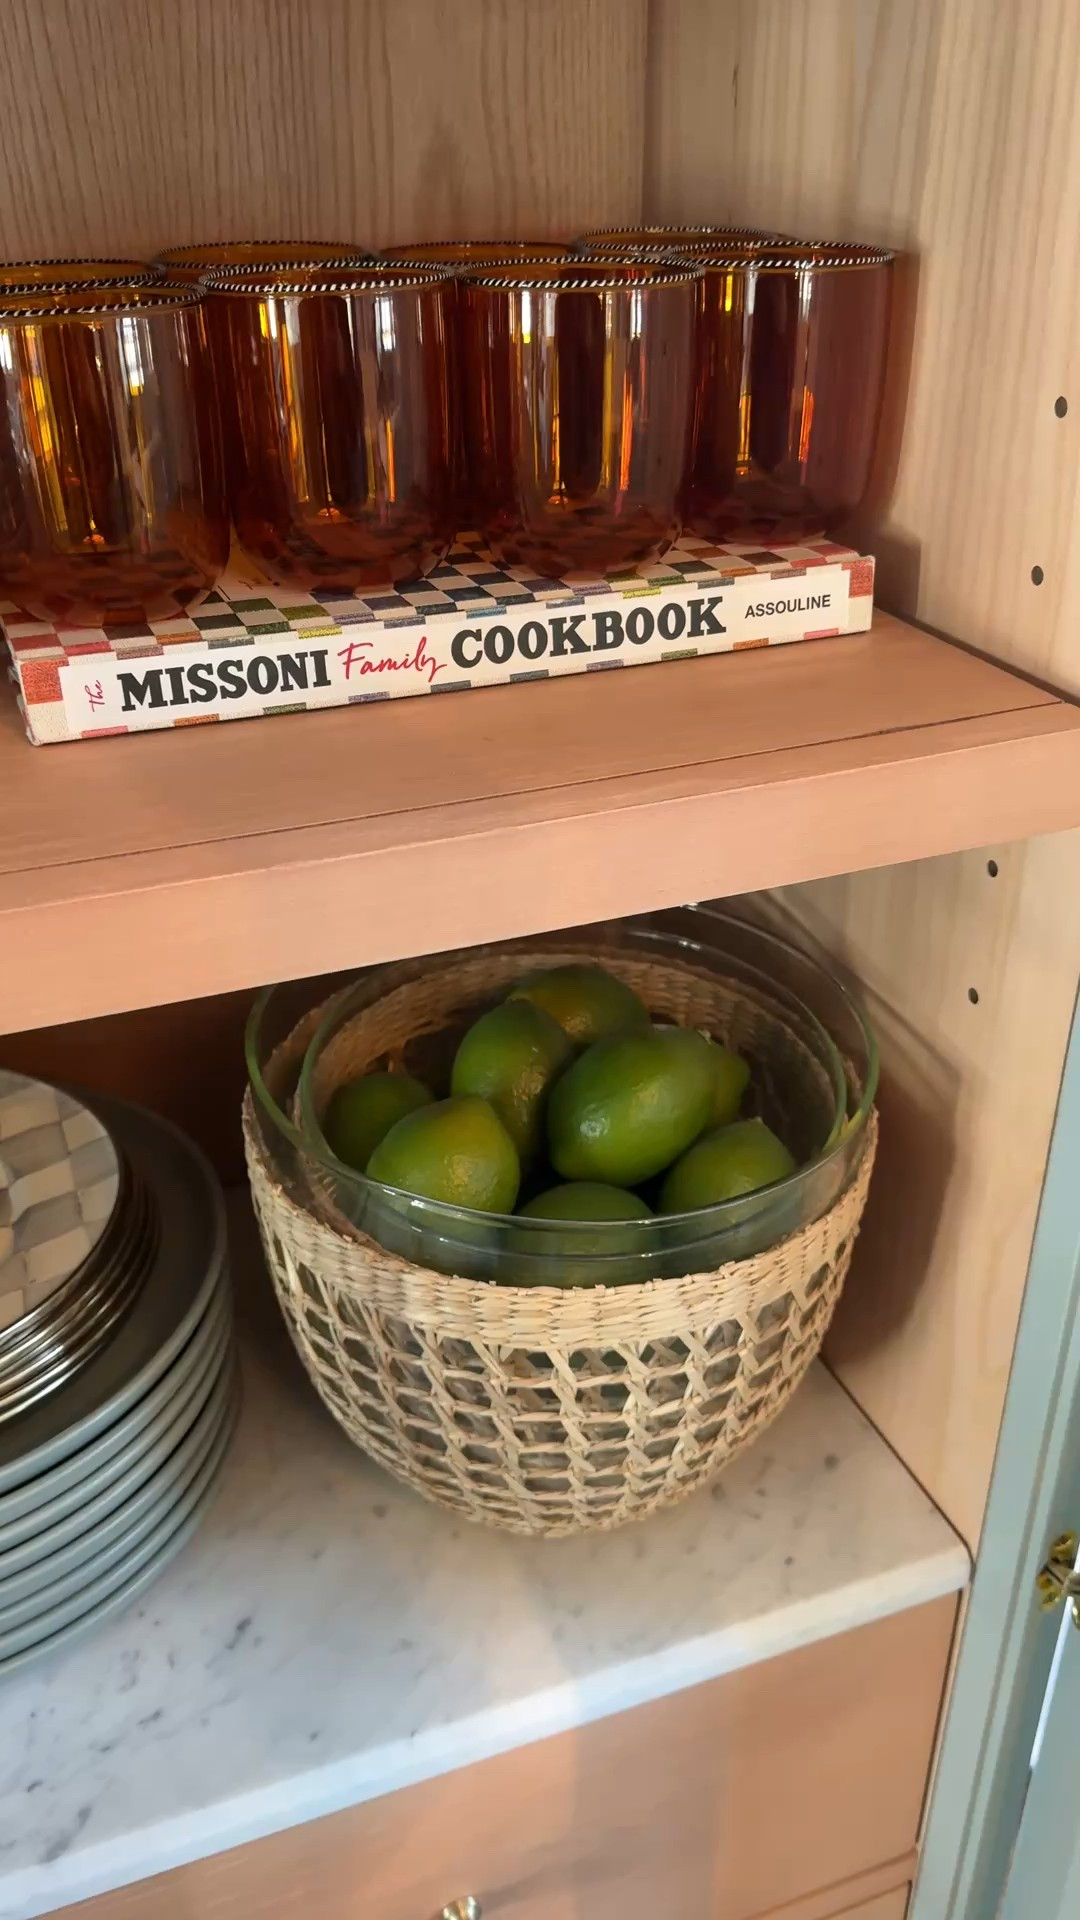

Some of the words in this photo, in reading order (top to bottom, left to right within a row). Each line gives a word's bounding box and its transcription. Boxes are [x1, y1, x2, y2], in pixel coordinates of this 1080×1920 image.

[117, 649, 331, 711] MISSONI
[337, 636, 448, 682] Family
[451, 596, 727, 668] COOKBOOK
[744, 594, 832, 619] ASSOULINE
